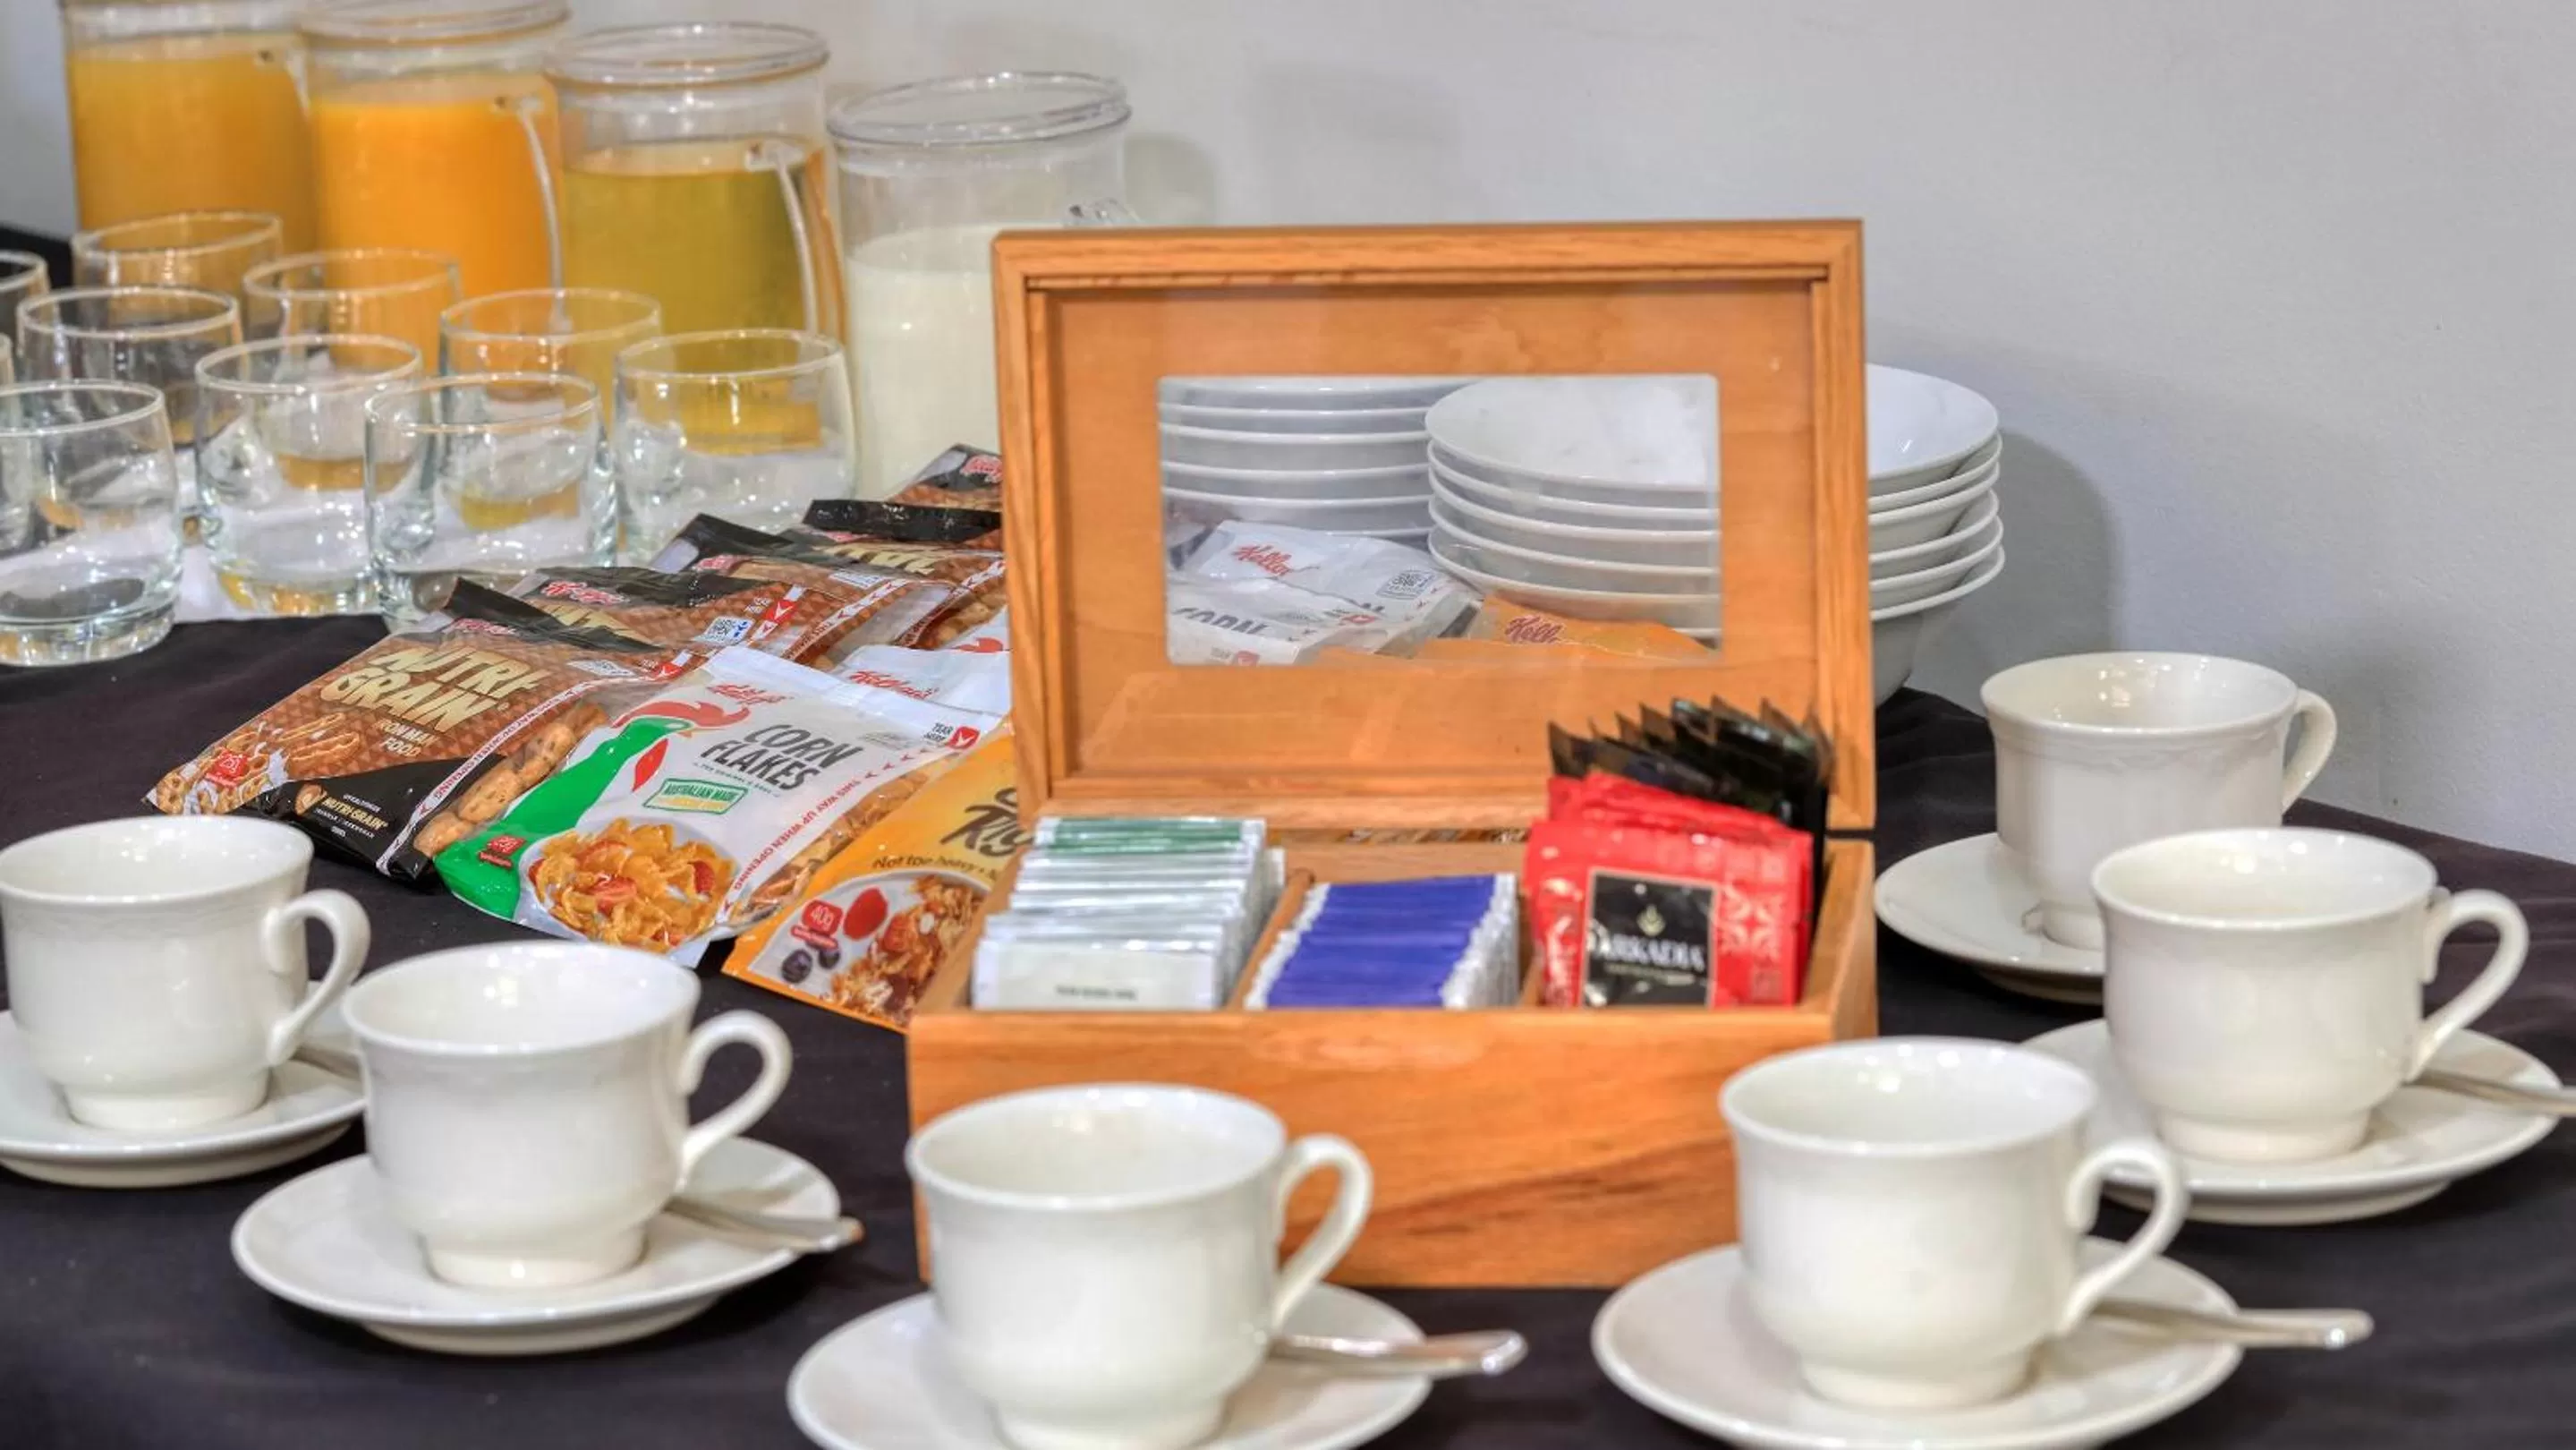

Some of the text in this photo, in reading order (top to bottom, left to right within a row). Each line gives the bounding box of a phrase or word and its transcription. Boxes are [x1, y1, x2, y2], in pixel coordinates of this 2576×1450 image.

[319, 667, 498, 733] GRAIN
[701, 739, 820, 789] FLAKES
[744, 724, 863, 769] CORN
[803, 810, 818, 824] UP
[734, 847, 774, 890] OPENING
